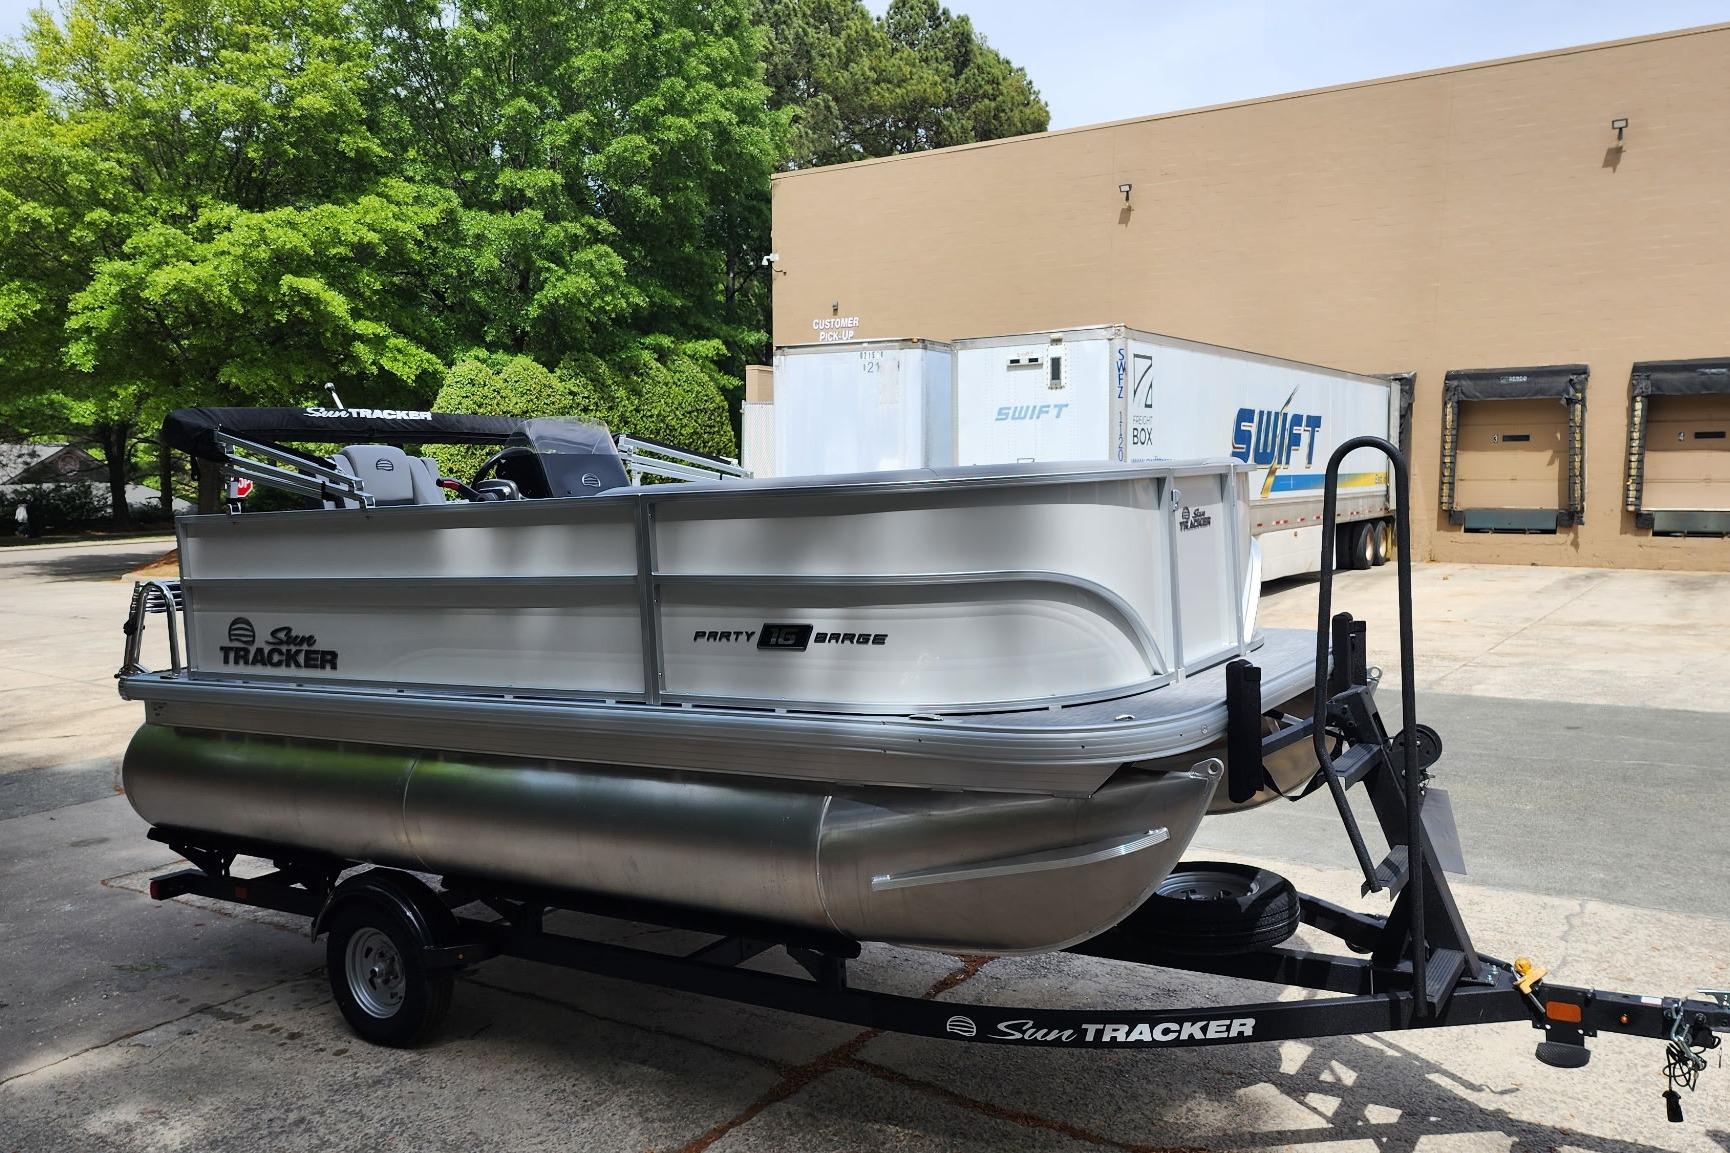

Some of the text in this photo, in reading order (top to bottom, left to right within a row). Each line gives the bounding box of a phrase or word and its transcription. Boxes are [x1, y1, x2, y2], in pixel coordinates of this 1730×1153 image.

[812, 317, 860, 330] CUSTOMER
[819, 330, 855, 342] PICK-UP
[303, 406, 433, 420] Sun TRACKER
[995, 403, 1070, 421] SWIFT
[1132, 427, 1153, 446] BOX
[1230, 407, 1322, 468] SWIFT
[264, 626, 317, 647] Sun
[693, 630, 756, 643] PARTY
[813, 632, 889, 646] BARGE
[219, 646, 339, 671] TRACKER
[987, 1017, 1257, 1043] Sun TRACKER
